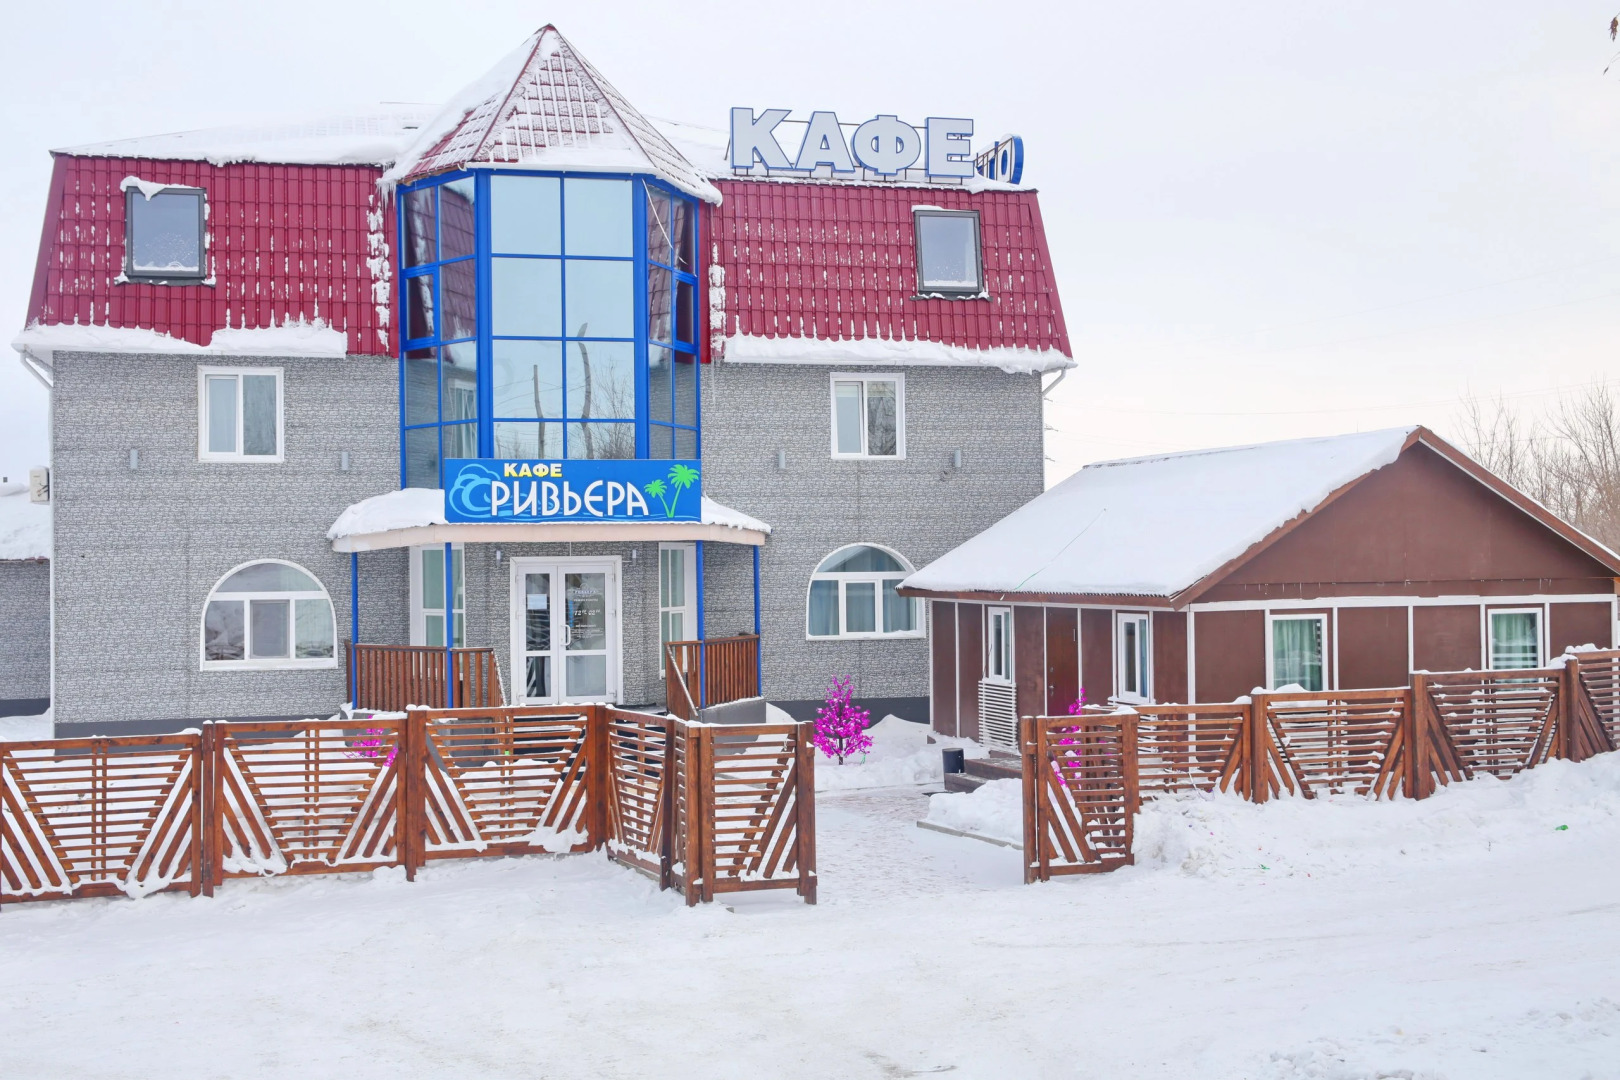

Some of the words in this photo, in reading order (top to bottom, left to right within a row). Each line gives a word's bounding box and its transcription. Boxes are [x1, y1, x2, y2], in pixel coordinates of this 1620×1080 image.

[730, 107, 974, 178] КАФЕ
[504, 463, 562, 478] КАФЕ
[491, 480, 649, 516] РИВЬЕРА
